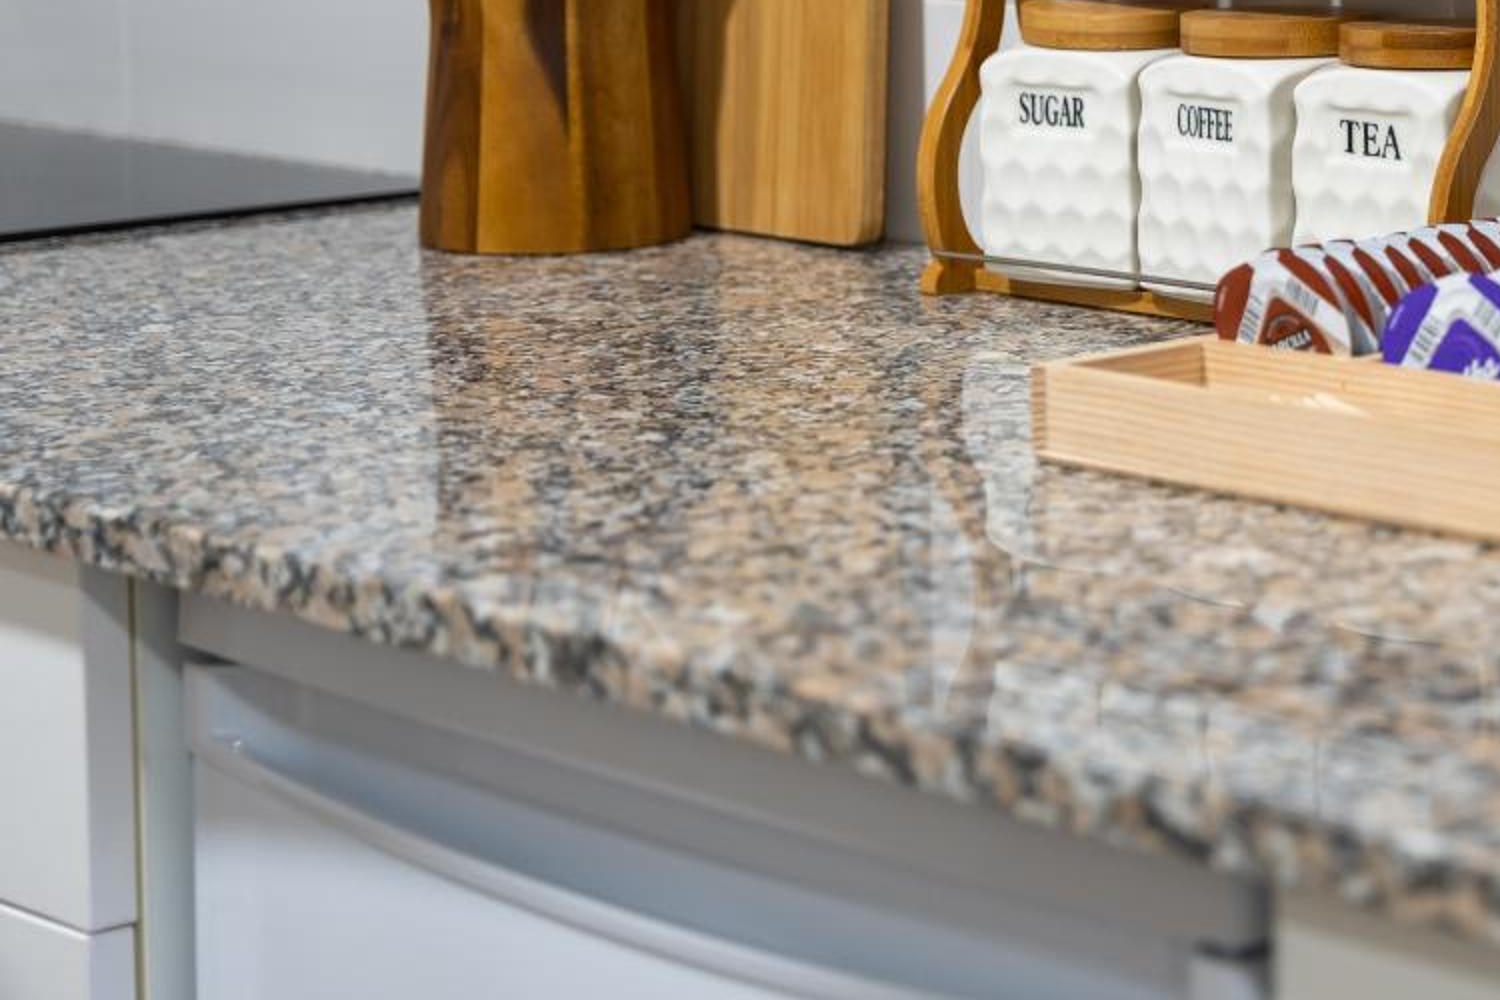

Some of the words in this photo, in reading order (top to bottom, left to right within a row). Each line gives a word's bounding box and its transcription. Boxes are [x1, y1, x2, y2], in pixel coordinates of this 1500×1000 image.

[1018, 93, 1085, 128] SUGAR
[1177, 104, 1233, 142] COFFEE
[1340, 119, 1401, 160] TEA
